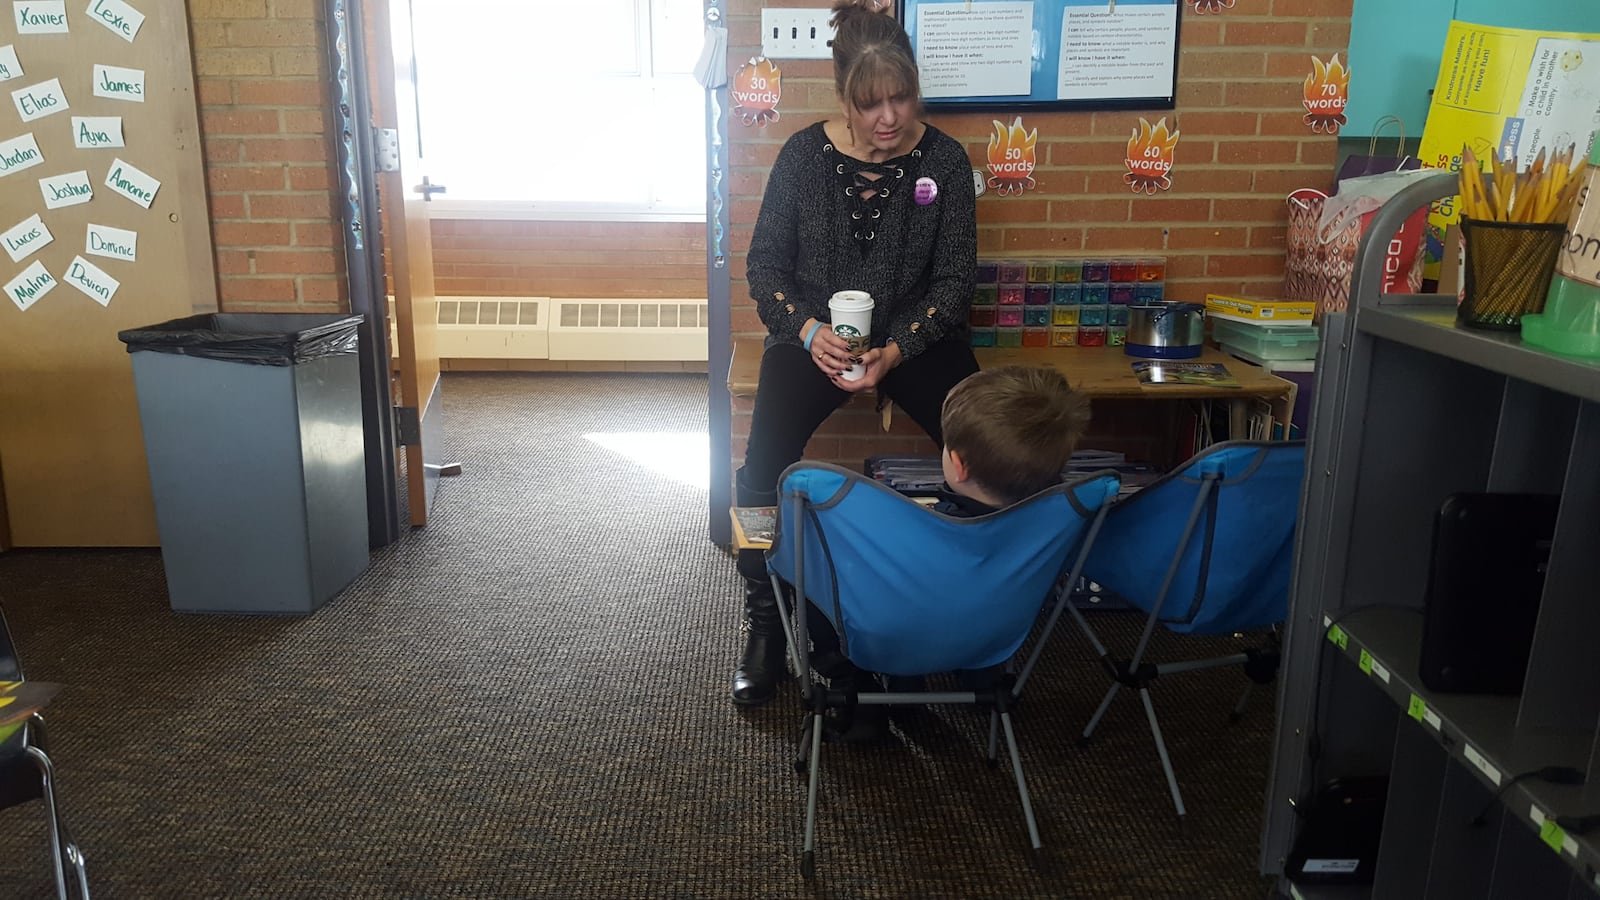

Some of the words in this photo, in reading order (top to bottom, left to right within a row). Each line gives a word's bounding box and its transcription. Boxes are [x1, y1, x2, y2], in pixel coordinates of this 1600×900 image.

[20, 7, 65, 27] Xavier
[94, 1, 131, 36] Lexie
[1543, 48, 1551, 60] for
[1474, 68, 1486, 92] Have
[1480, 49, 1490, 67] fun!
[1539, 58, 1548, 77] wish
[1546, 51, 1558, 81] another
[100, 70, 142, 94] James
[750, 77, 767, 90] 30
[1321, 83, 1337, 97] 70
[1541, 80, 1549, 89] in
[19, 92, 58, 116] Elias
[737, 91, 778, 103] words
[1308, 96, 1347, 109] words
[1528, 85, 1540, 107] Make
[1537, 89, 1548, 109] child
[0, 147, 38, 171] Jordan
[1005, 148, 1021, 160] 50
[1144, 146, 1160, 158] 60
[993, 160, 1034, 172] words
[1130, 159, 1170, 171] words
[50, 183, 91, 202] Joshua
[6, 227, 42, 252] Lucas
[90, 231, 135, 257] Dominic
[14, 272, 53, 304] Malina
[71, 262, 110, 300] Devion
[1413, 699, 1420, 715] 4
